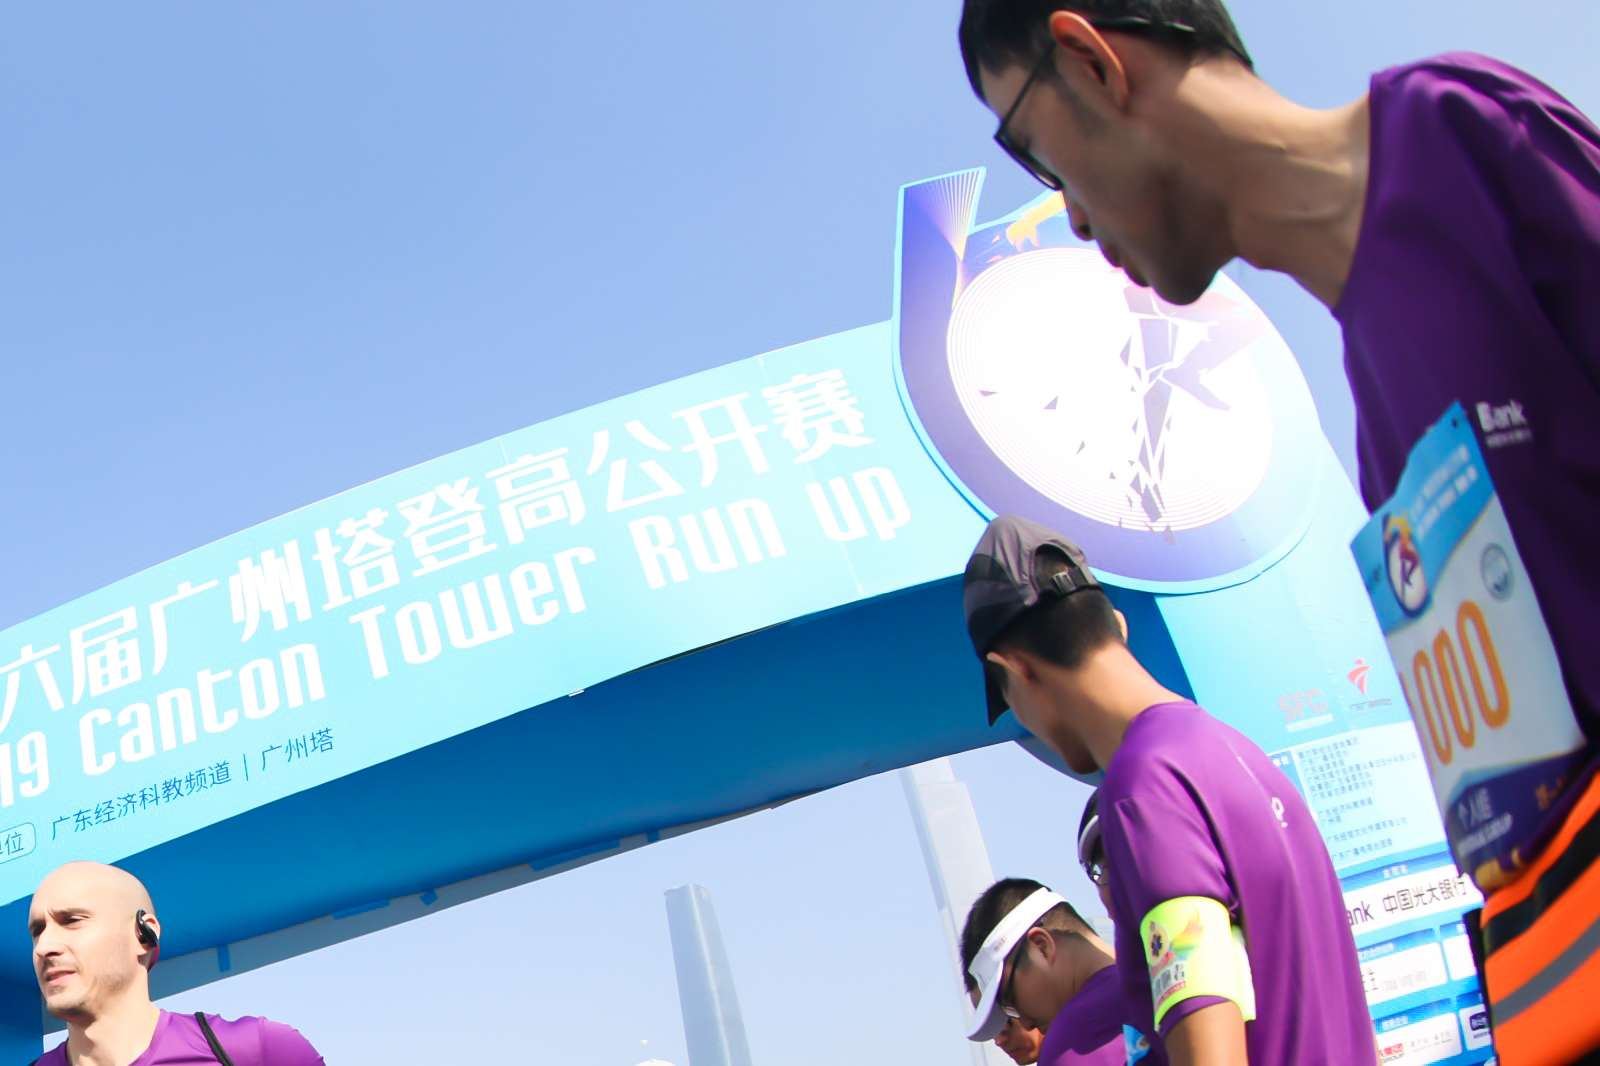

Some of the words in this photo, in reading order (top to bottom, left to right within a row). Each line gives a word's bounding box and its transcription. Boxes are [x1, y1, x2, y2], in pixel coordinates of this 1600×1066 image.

[79, 643, 325, 775] Canton
[350, 547, 596, 679] Tower
[628, 498, 787, 589] Run
[1399, 600, 1511, 777] 000
[52, 760, 232, 840] 广东经济科教频道
[261, 726, 335, 771] 广州塔
[1382, 878, 1468, 915] 中国光大银行
